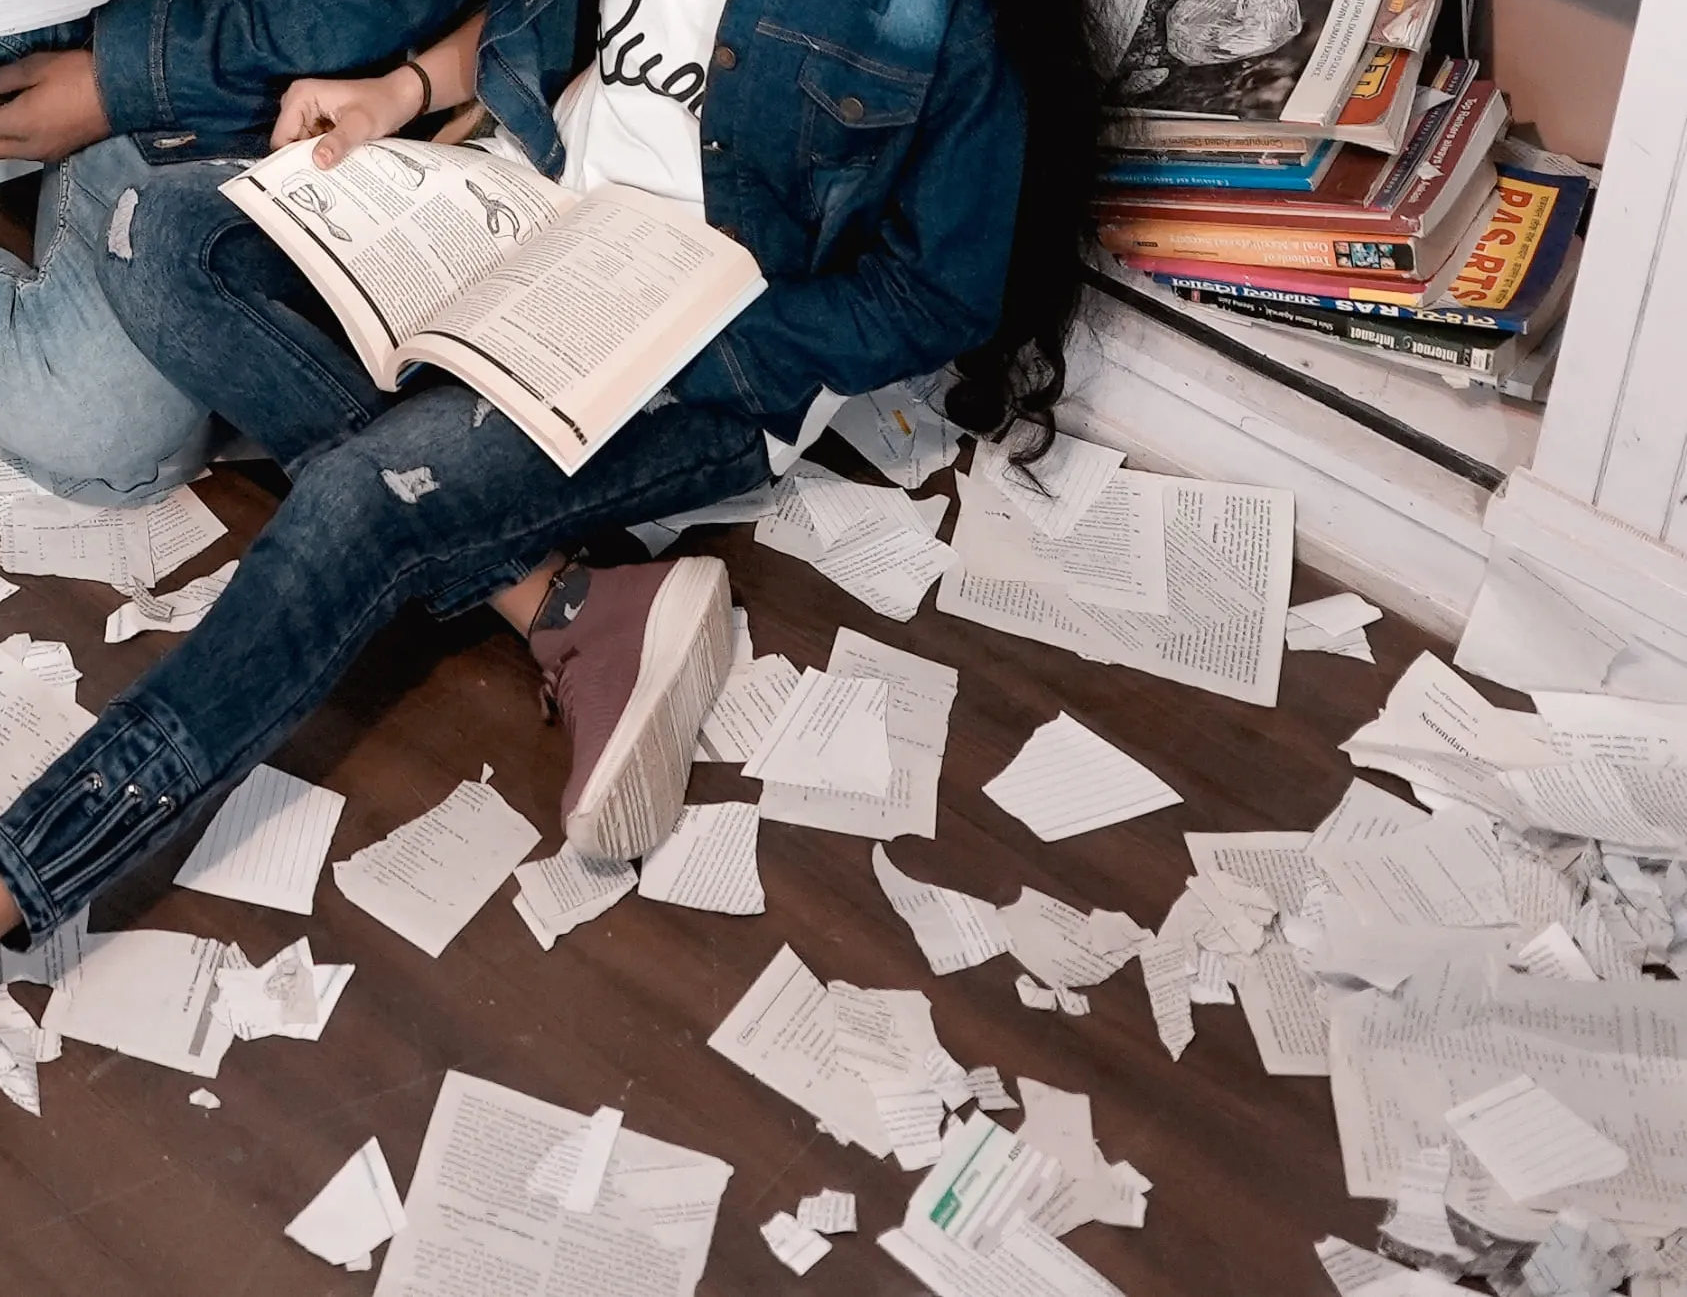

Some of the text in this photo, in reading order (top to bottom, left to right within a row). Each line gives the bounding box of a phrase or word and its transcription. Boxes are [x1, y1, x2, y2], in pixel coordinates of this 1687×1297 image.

[1324, 17, 1341, 45] HUMAN
[1335, 20, 1355, 56] DIAMOND
[1235, 137, 1282, 148] Computer
[1242, 283, 1498, 330] लक्ष्य RAS सामान्य
[1348, 323, 1459, 364] Internet Intranet
[1418, 710, 1474, 759] Secondary
